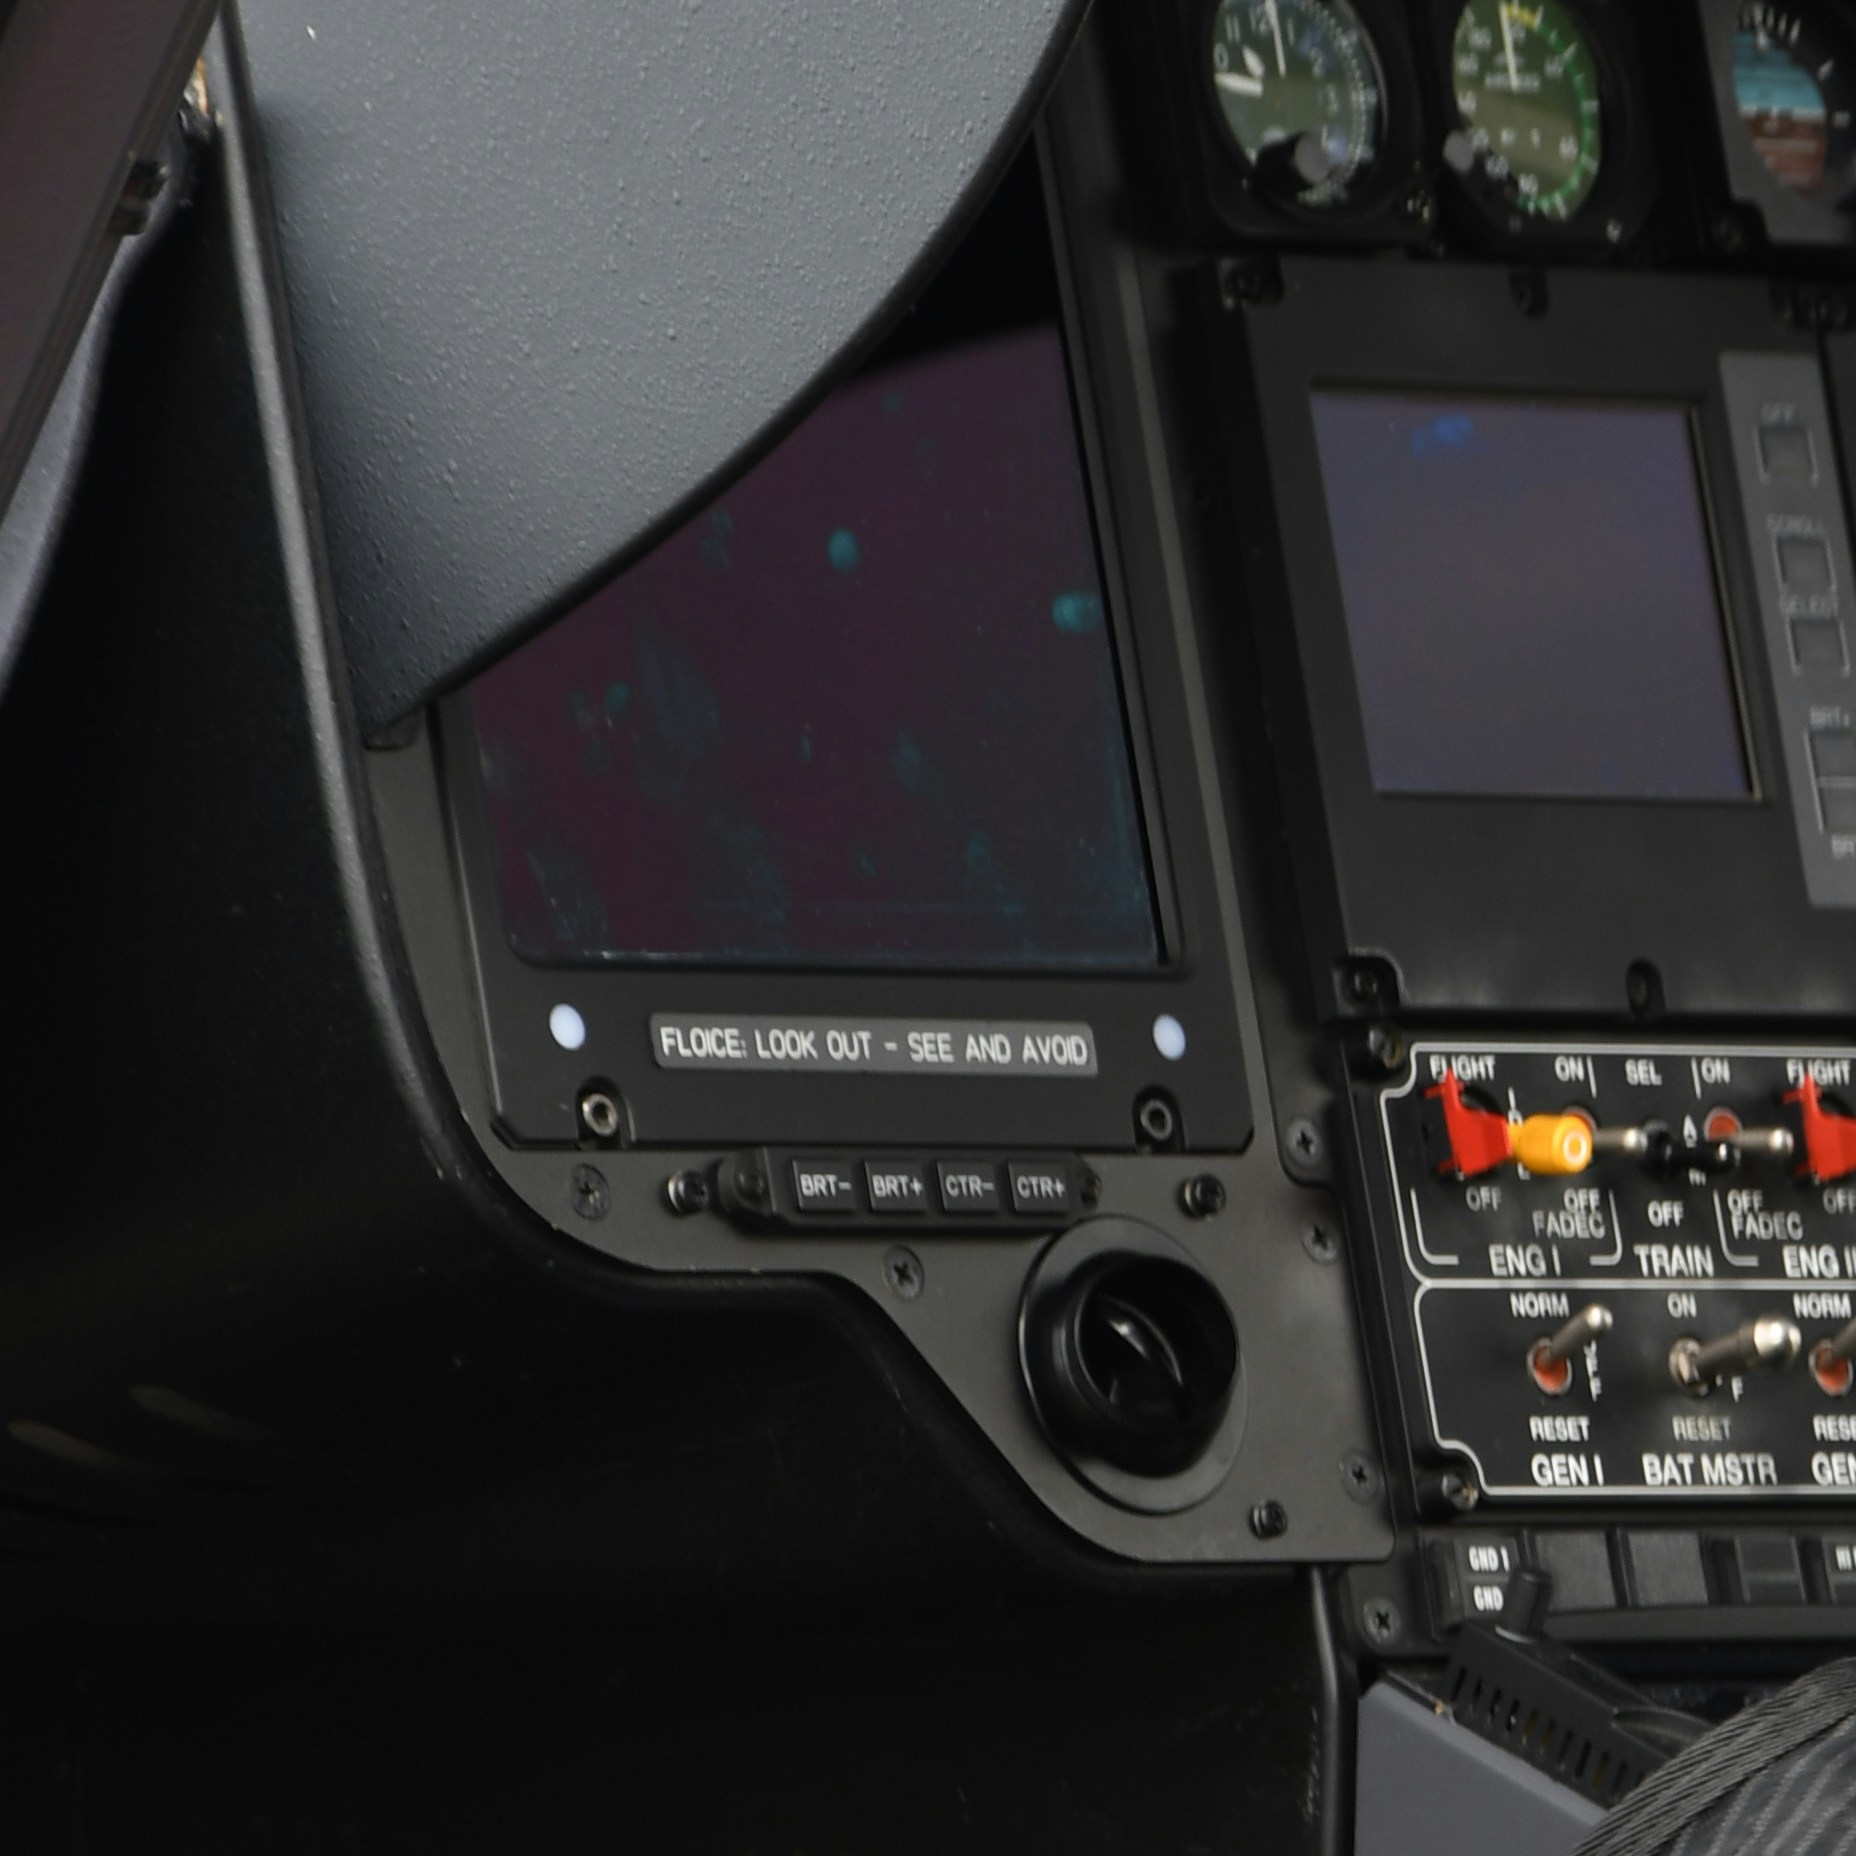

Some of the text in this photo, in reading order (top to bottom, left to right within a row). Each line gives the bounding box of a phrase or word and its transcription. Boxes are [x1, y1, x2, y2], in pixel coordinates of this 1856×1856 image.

[660, 1026, 748, 1059] FLOICE:
[754, 1028, 818, 1061] LOOK
[826, 1030, 872, 1062] OUT
[907, 1031, 954, 1063] SEE
[965, 1033, 1012, 1064] AND
[1022, 1034, 1089, 1066] AVOID
[1555, 1055, 1585, 1082] ON
[1625, 1059, 1663, 1086] SEL
[1701, 1057, 1730, 1084] ON
[800, 1173, 852, 1199] BRT-
[872, 1174, 924, 1199] BRT+
[945, 1174, 995, 1198] CTR-
[1016, 1175, 1066, 1199] CTR+
[1466, 1186, 1503, 1212] OFF
[1564, 1188, 1601, 1213] OFF
[1648, 1200, 1685, 1227] OFF
[1727, 1190, 1764, 1214] OFF
[1532, 1210, 1606, 1239] FADEC
[1731, 1211, 1804, 1241] FADEC
[1489, 1244, 1548, 1277] ENG
[1633, 1244, 1715, 1278] TRAIN
[1782, 1246, 1841, 1279] ENG
[1510, 1292, 1570, 1318] NORM
[1667, 1292, 1698, 1318] ON
[1793, 1292, 1852, 1319] NORM
[1529, 1415, 1591, 1442] RESET
[1672, 1415, 1732, 1442] RESET
[1531, 1452, 1590, 1486] GEN
[1641, 1452, 1778, 1487] BAT MSTR
[1468, 1546, 1500, 1572] GND
[1472, 1585, 1504, 1611] GND
